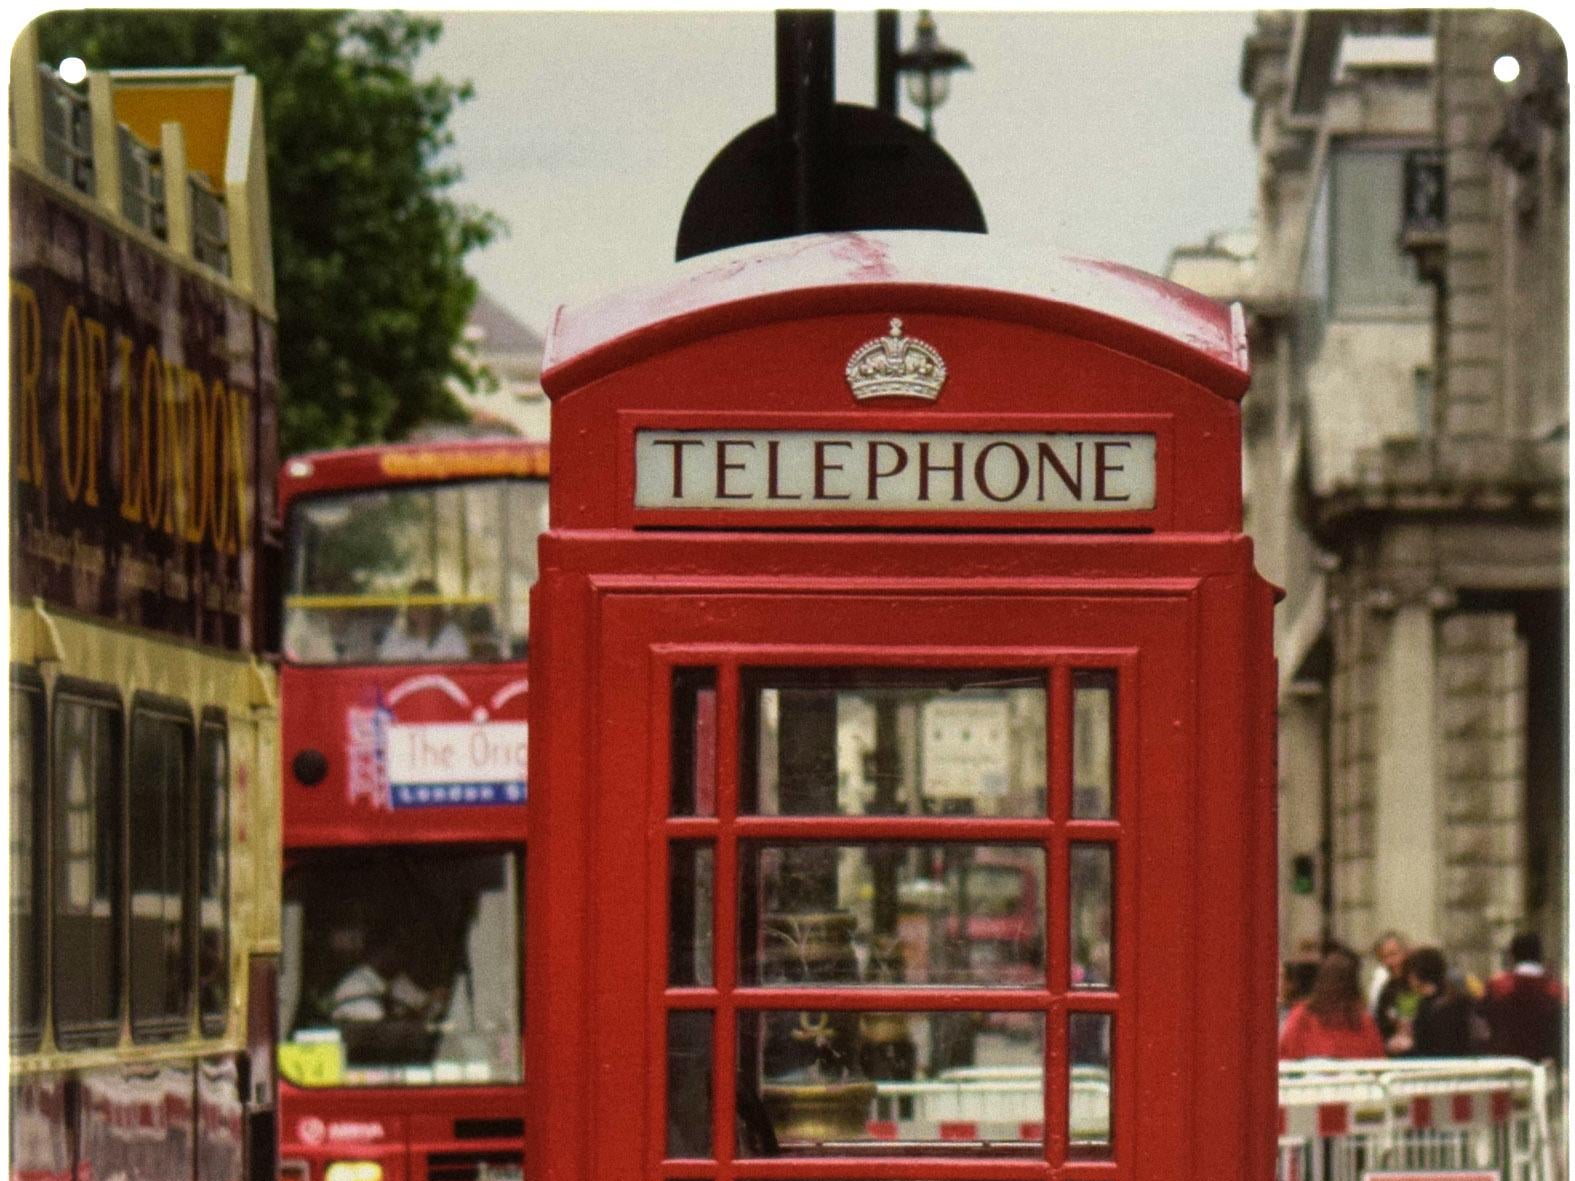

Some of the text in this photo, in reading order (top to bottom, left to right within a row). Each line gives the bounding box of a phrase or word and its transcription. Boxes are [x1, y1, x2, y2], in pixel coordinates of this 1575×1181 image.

[60, 305, 107, 507] OF
[117, 334, 251, 556] LONDON
[652, 439, 1133, 502] TELEPHONE
